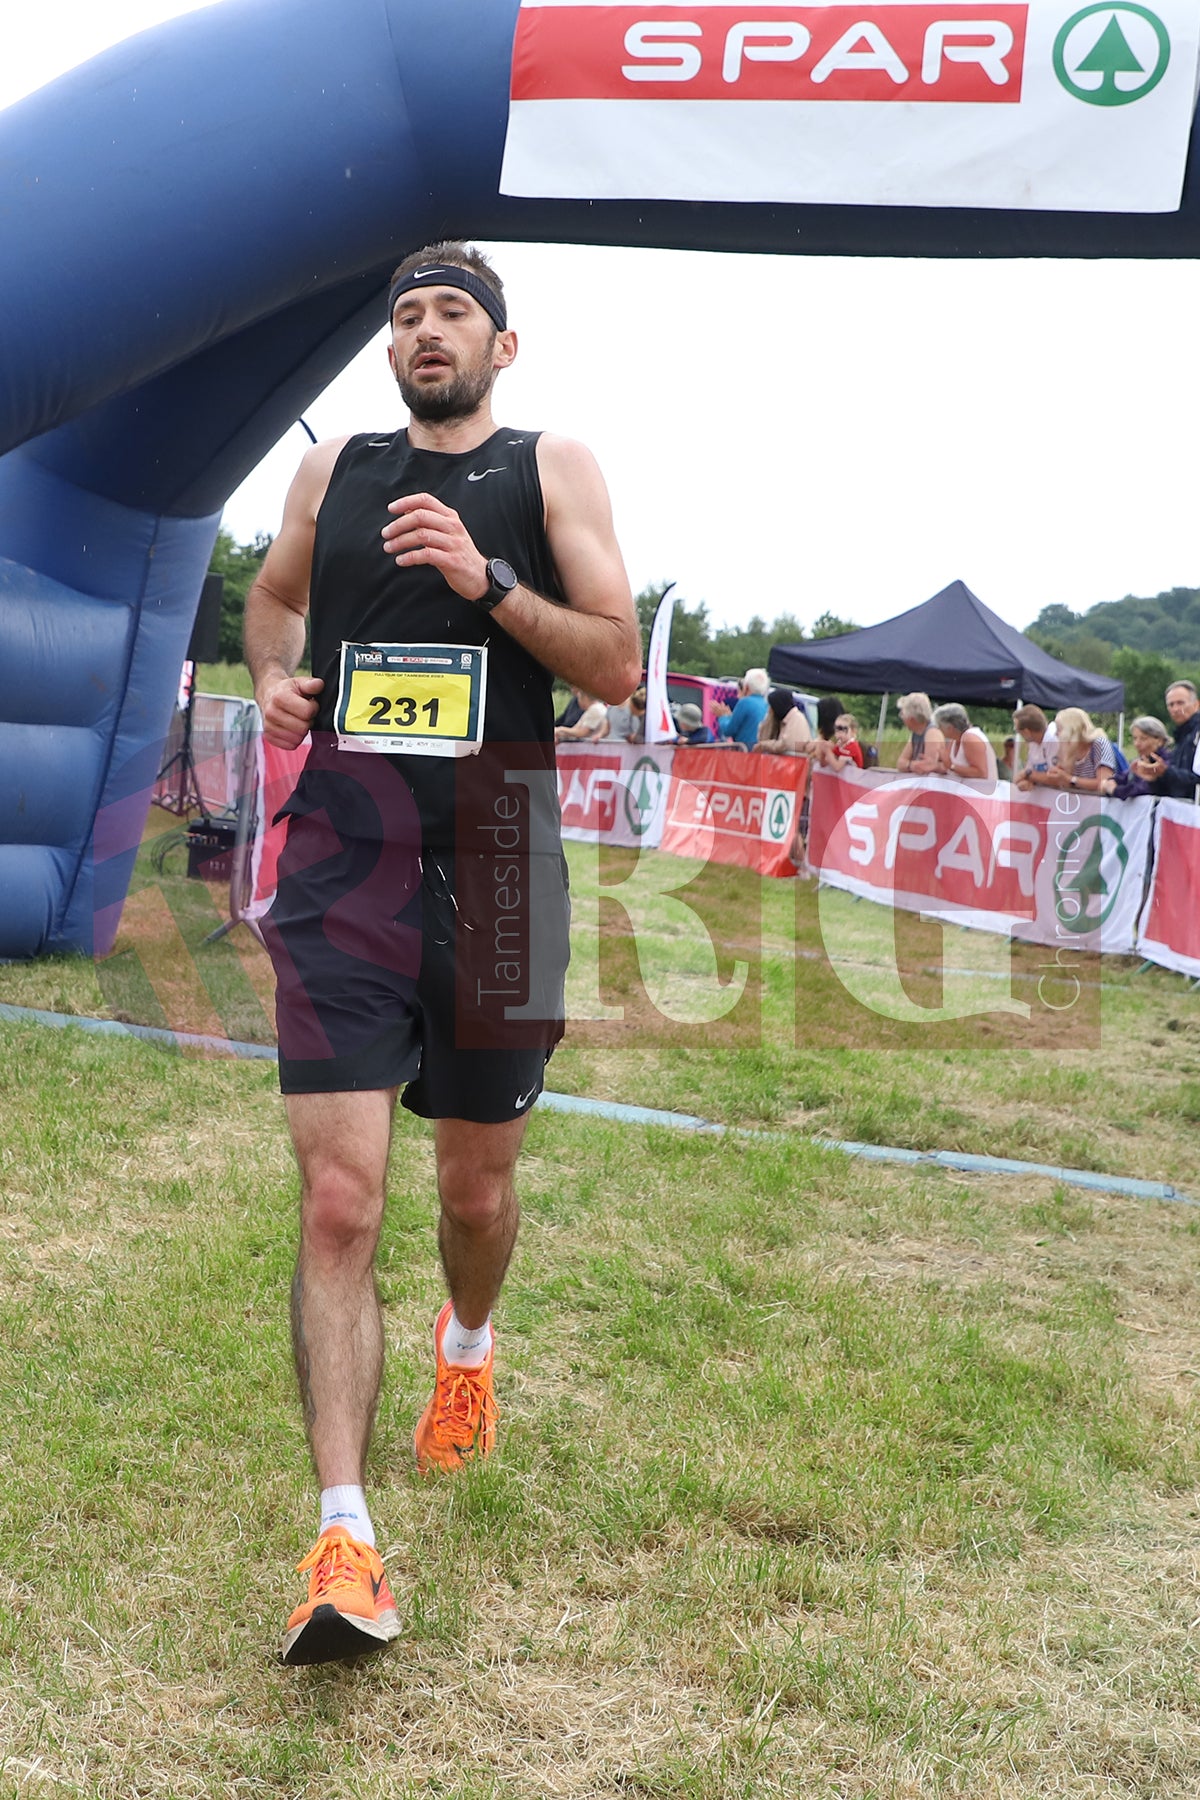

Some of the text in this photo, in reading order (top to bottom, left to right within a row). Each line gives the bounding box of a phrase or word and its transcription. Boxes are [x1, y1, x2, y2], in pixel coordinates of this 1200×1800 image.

[621, 20, 1014, 85] SPAR
[367, 696, 440, 728] 231
[692, 789, 764, 828] SPAR
[844, 800, 1042, 898] SPAR
